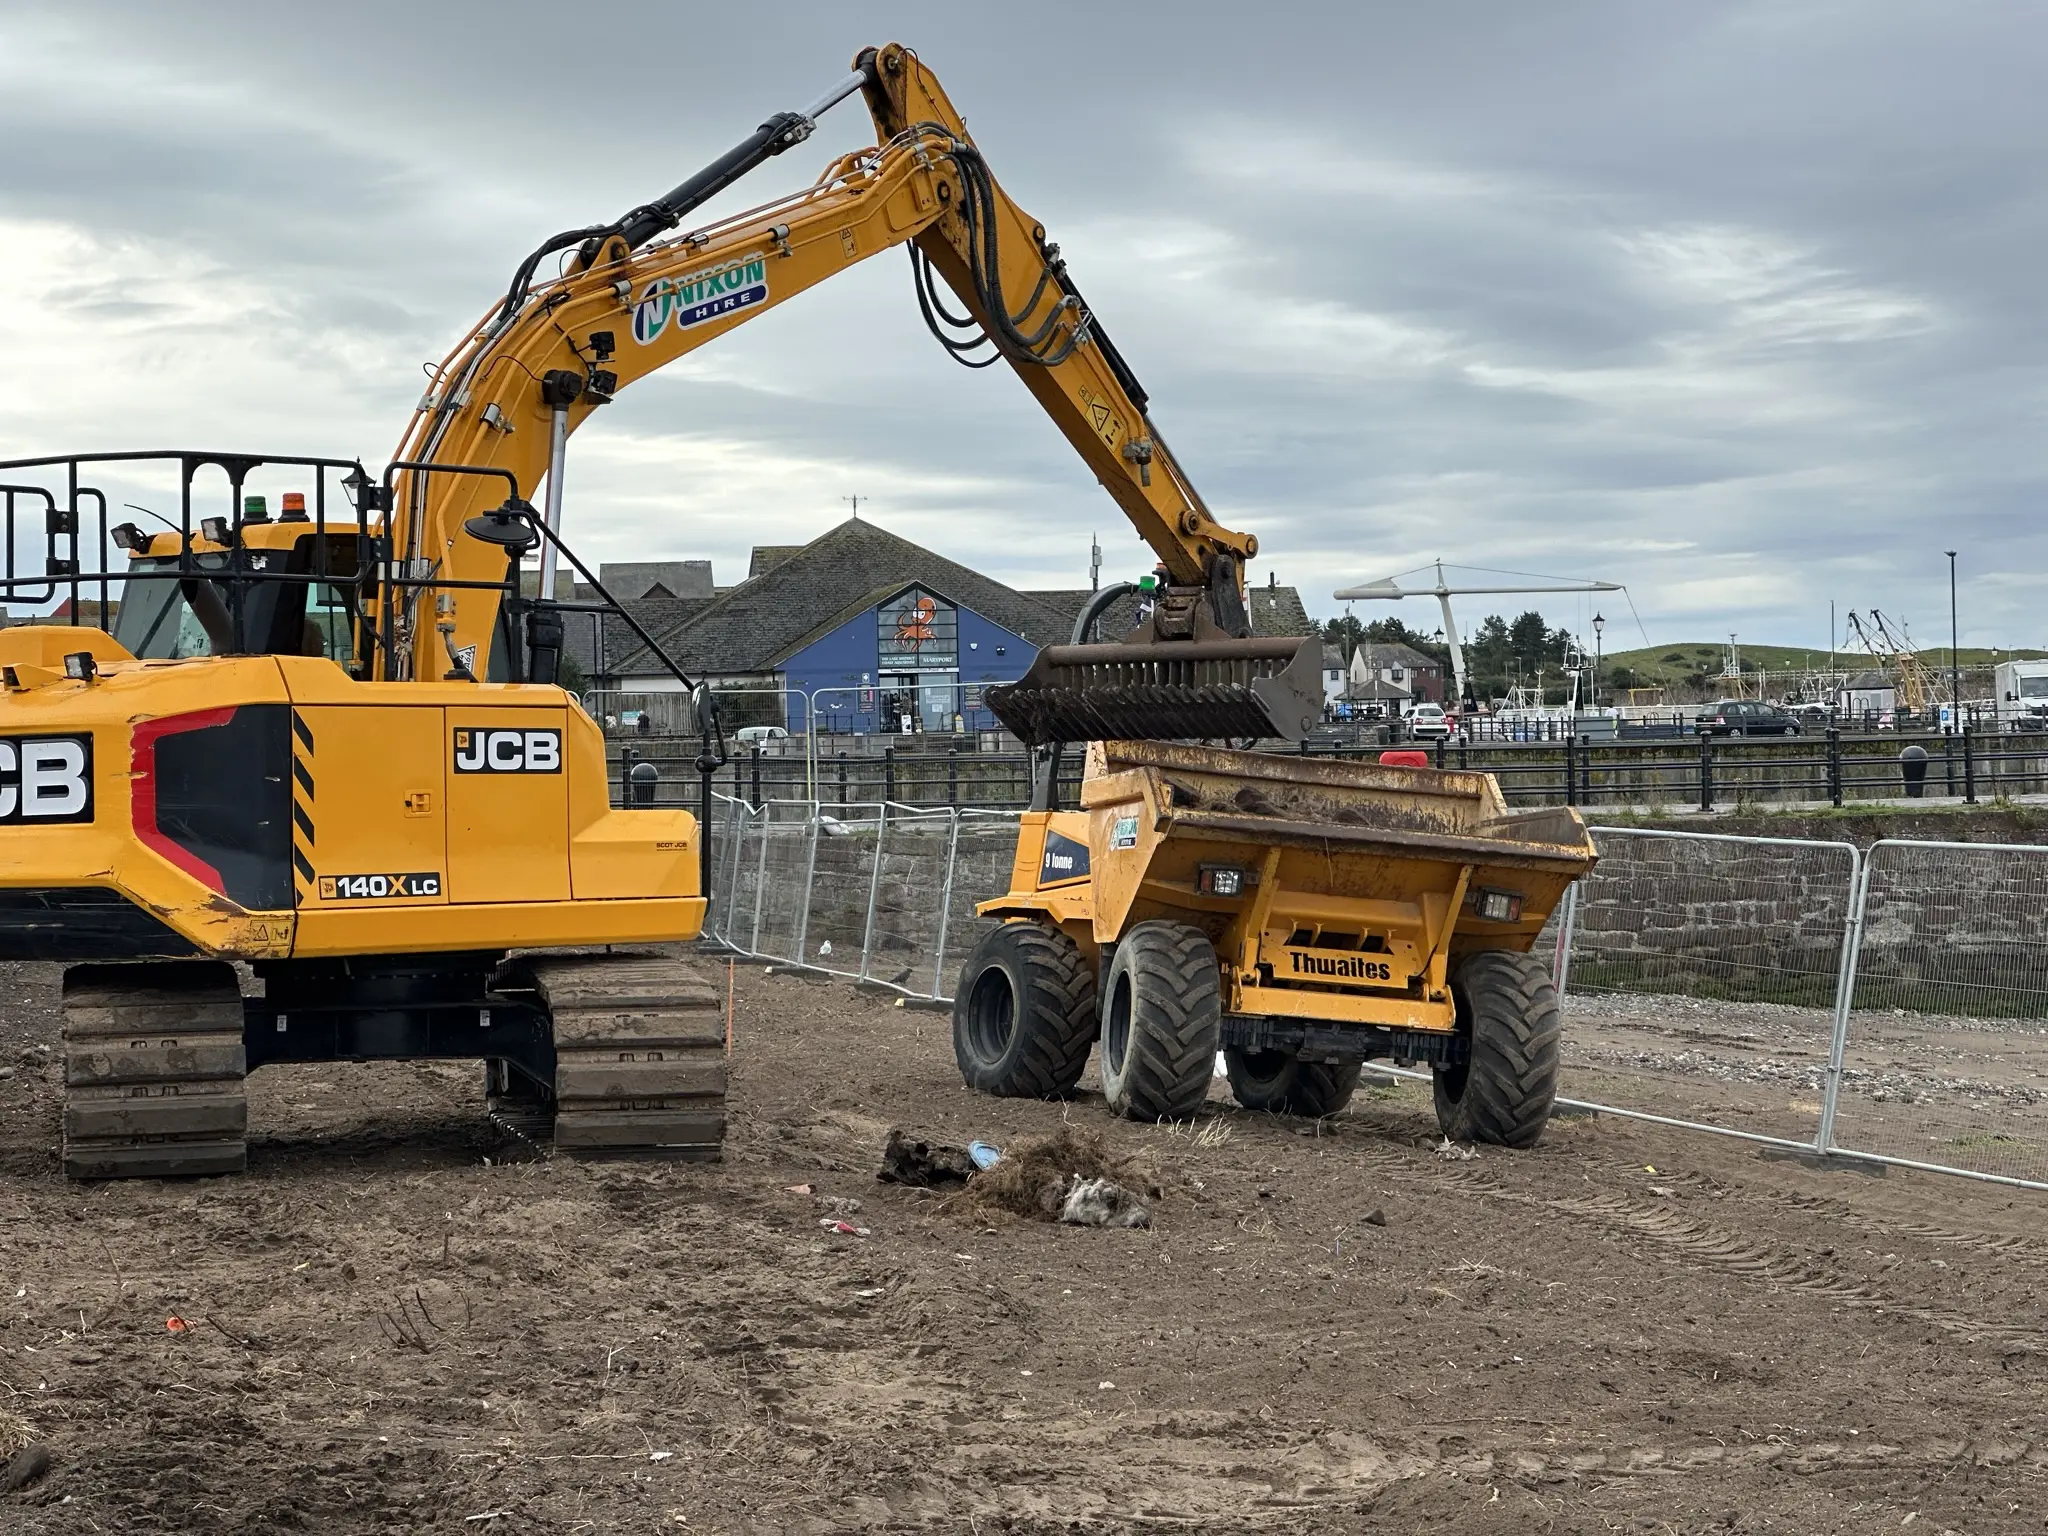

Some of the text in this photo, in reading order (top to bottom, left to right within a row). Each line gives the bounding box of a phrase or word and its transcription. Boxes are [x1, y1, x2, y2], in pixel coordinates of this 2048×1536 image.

[674, 255, 765, 308] NIXON
[695, 292, 751, 319] HIRE
[1942, 711, 1948, 720] P
[457, 731, 560, 770] JCB
[1045, 852, 1050, 868] 9
[337, 876, 408, 897] 140X
[411, 879, 438, 895] LC
[1290, 951, 1391, 981] Thwaites
